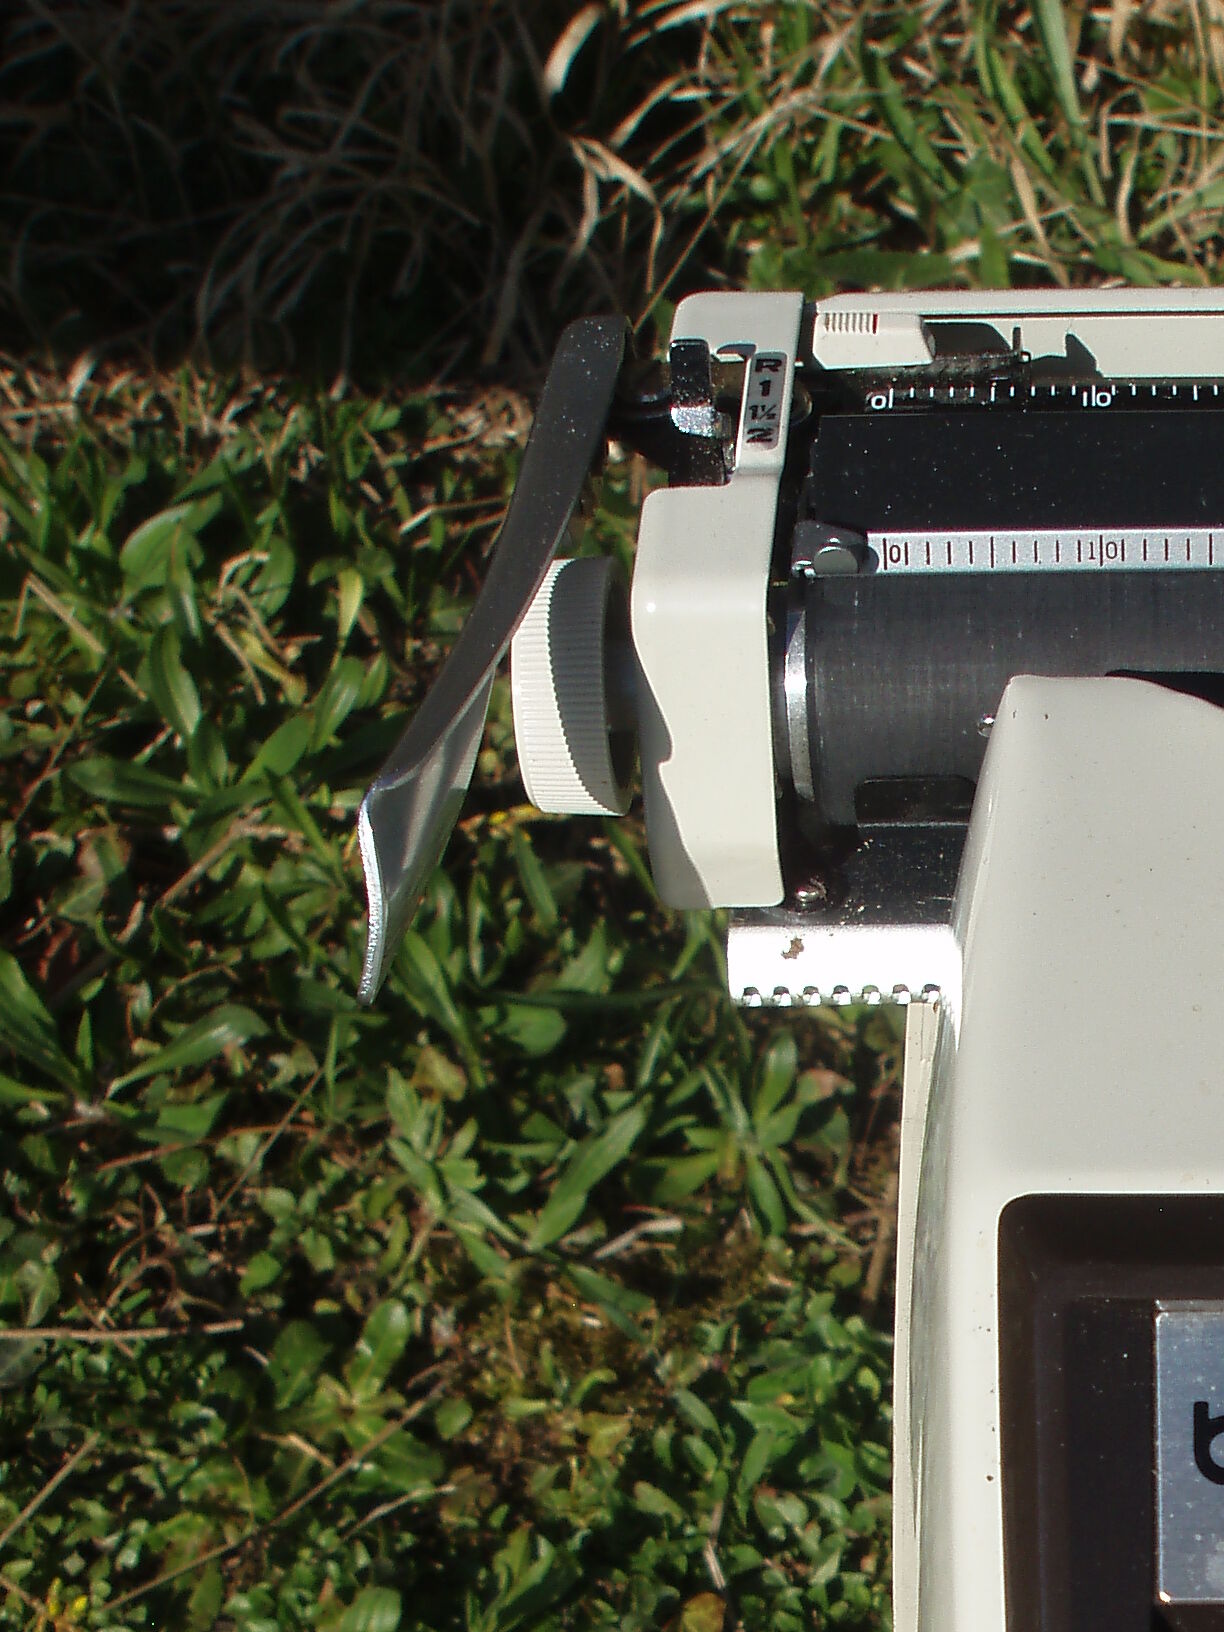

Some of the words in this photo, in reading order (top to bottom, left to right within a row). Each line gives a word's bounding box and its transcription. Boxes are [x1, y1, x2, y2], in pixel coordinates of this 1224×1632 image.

[755, 358, 782, 372] R
[759, 379, 772, 397] 1
[871, 394, 885, 410] 0
[1083, 391, 1112, 408] 10
[746, 427, 774, 444] 2
[888, 543, 902, 564] 0
[1087, 540, 1119, 562] 10
